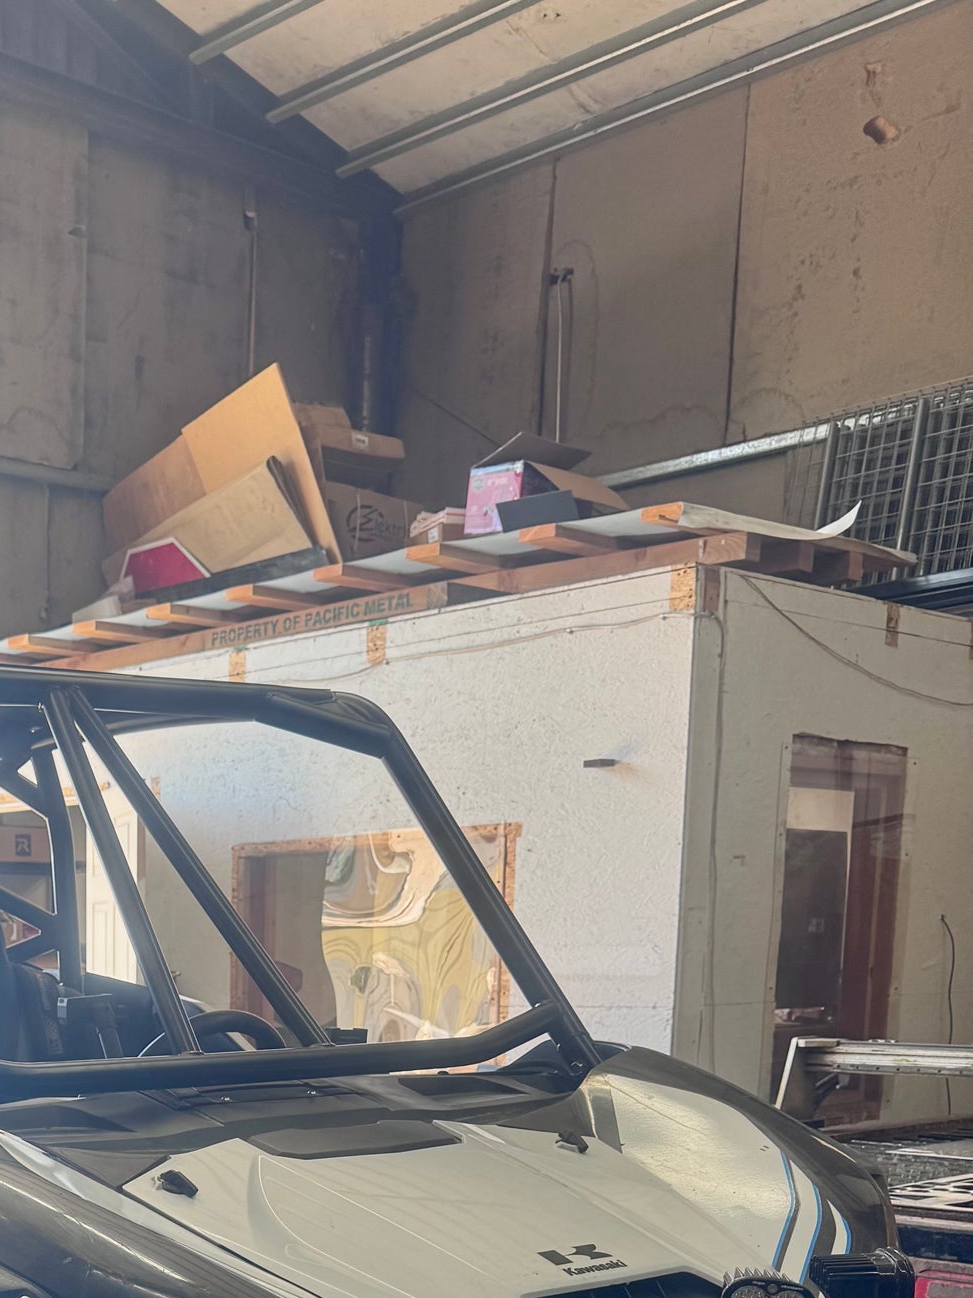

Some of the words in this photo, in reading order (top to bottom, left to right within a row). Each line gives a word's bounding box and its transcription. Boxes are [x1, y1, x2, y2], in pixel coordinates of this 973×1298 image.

[211, 619, 279, 645] PROPERTY
[282, 617, 300, 632] OF
[304, 602, 359, 628] PACIFIC
[364, 592, 413, 616] METAL
[562, 1259, 628, 1277] Kawasaki
